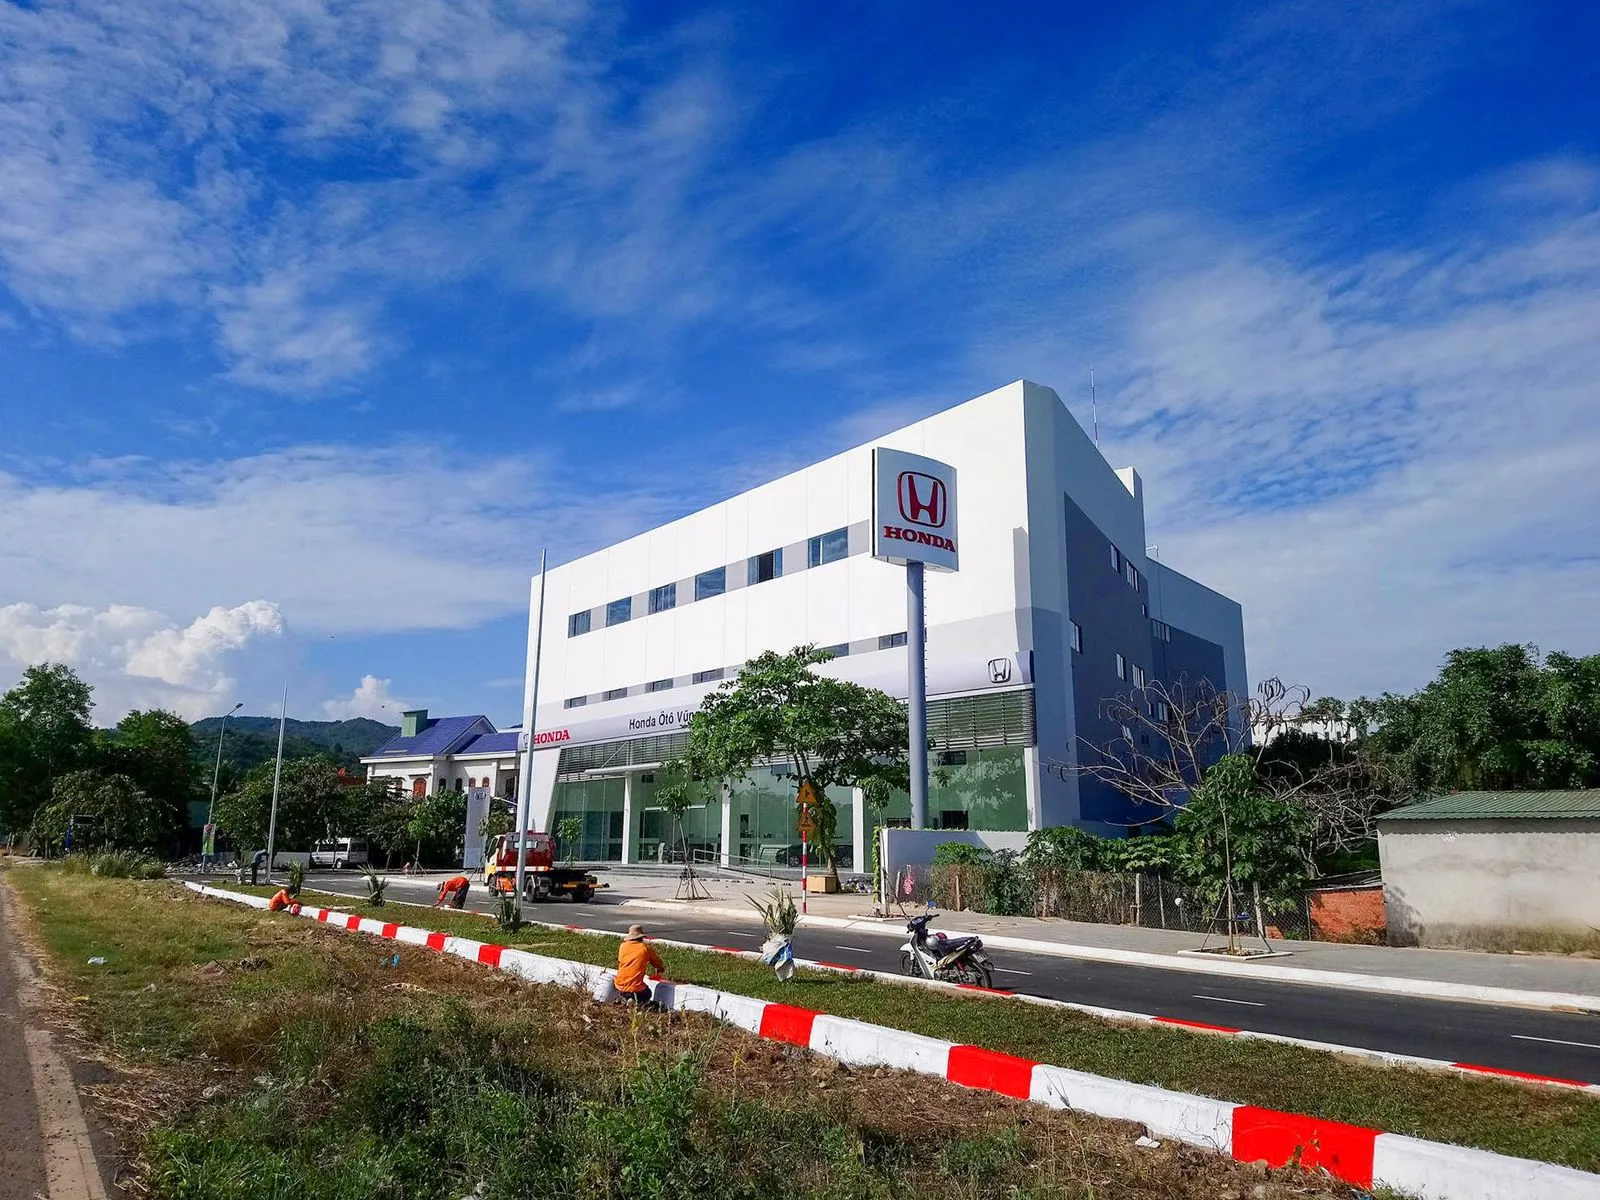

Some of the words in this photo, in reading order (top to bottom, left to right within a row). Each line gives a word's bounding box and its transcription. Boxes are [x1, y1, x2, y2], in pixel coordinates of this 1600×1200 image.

[883, 525, 956, 553] HONDA
[628, 715, 656, 730] Honda
[658, 710, 675, 726] Ôtô
[676, 709, 696, 724] Vũn
[533, 729, 571, 745] HONDA
